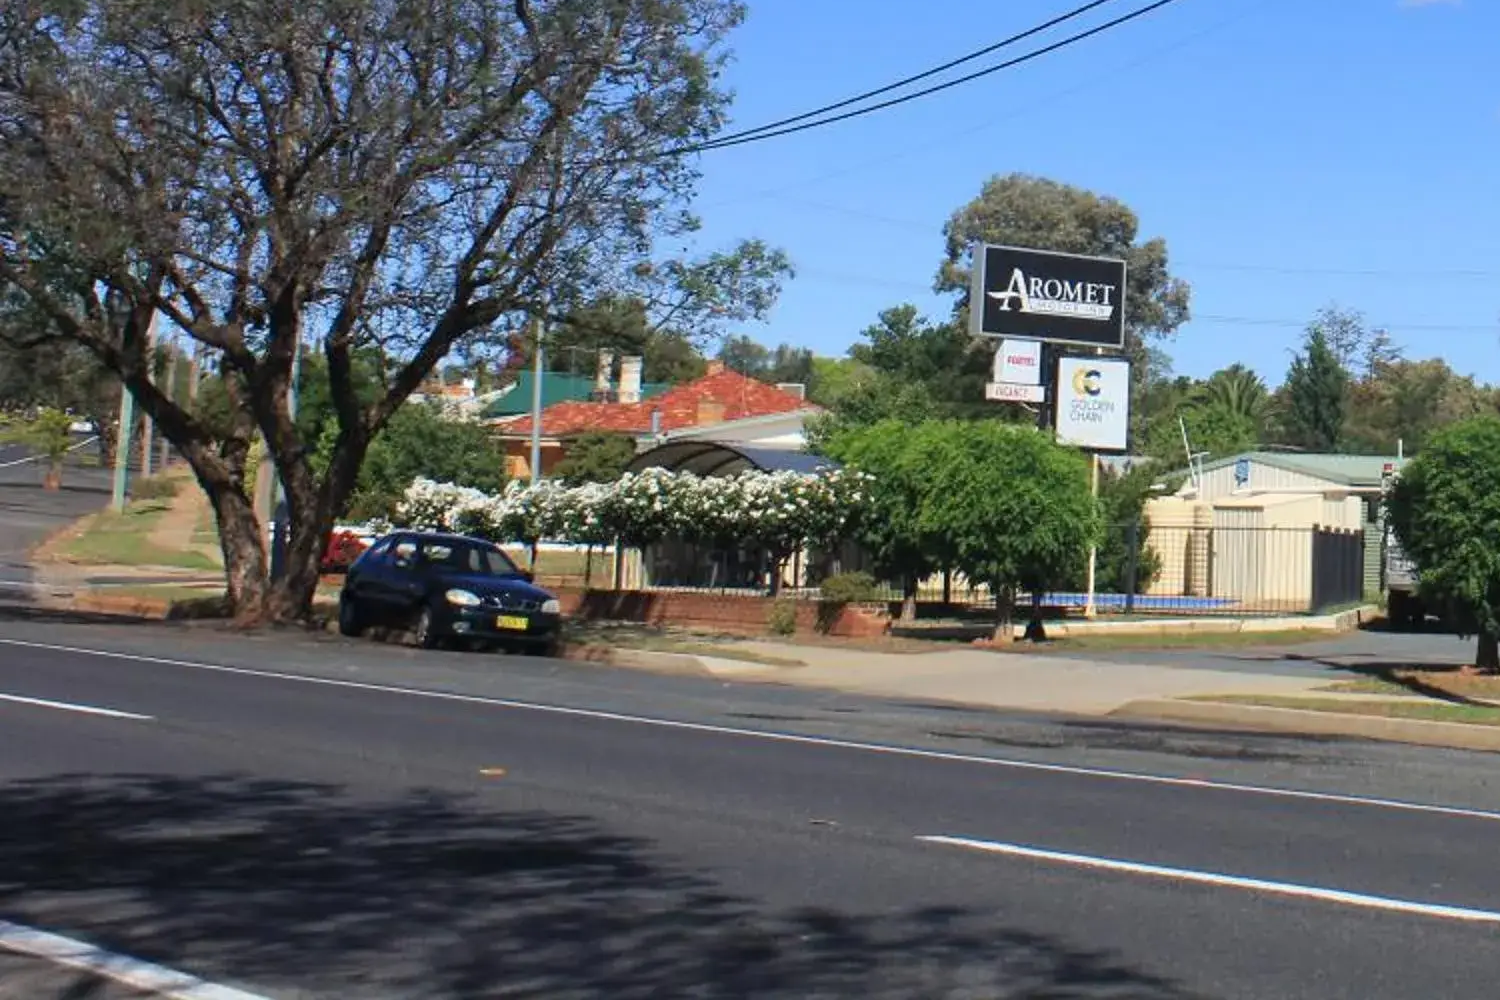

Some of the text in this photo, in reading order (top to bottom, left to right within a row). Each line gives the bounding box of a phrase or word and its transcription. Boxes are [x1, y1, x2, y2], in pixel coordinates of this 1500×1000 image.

[987, 267, 1115, 313] AROMET
[1071, 399, 1115, 413] GOLDEN
[1070, 411, 1103, 423] CHAIN
